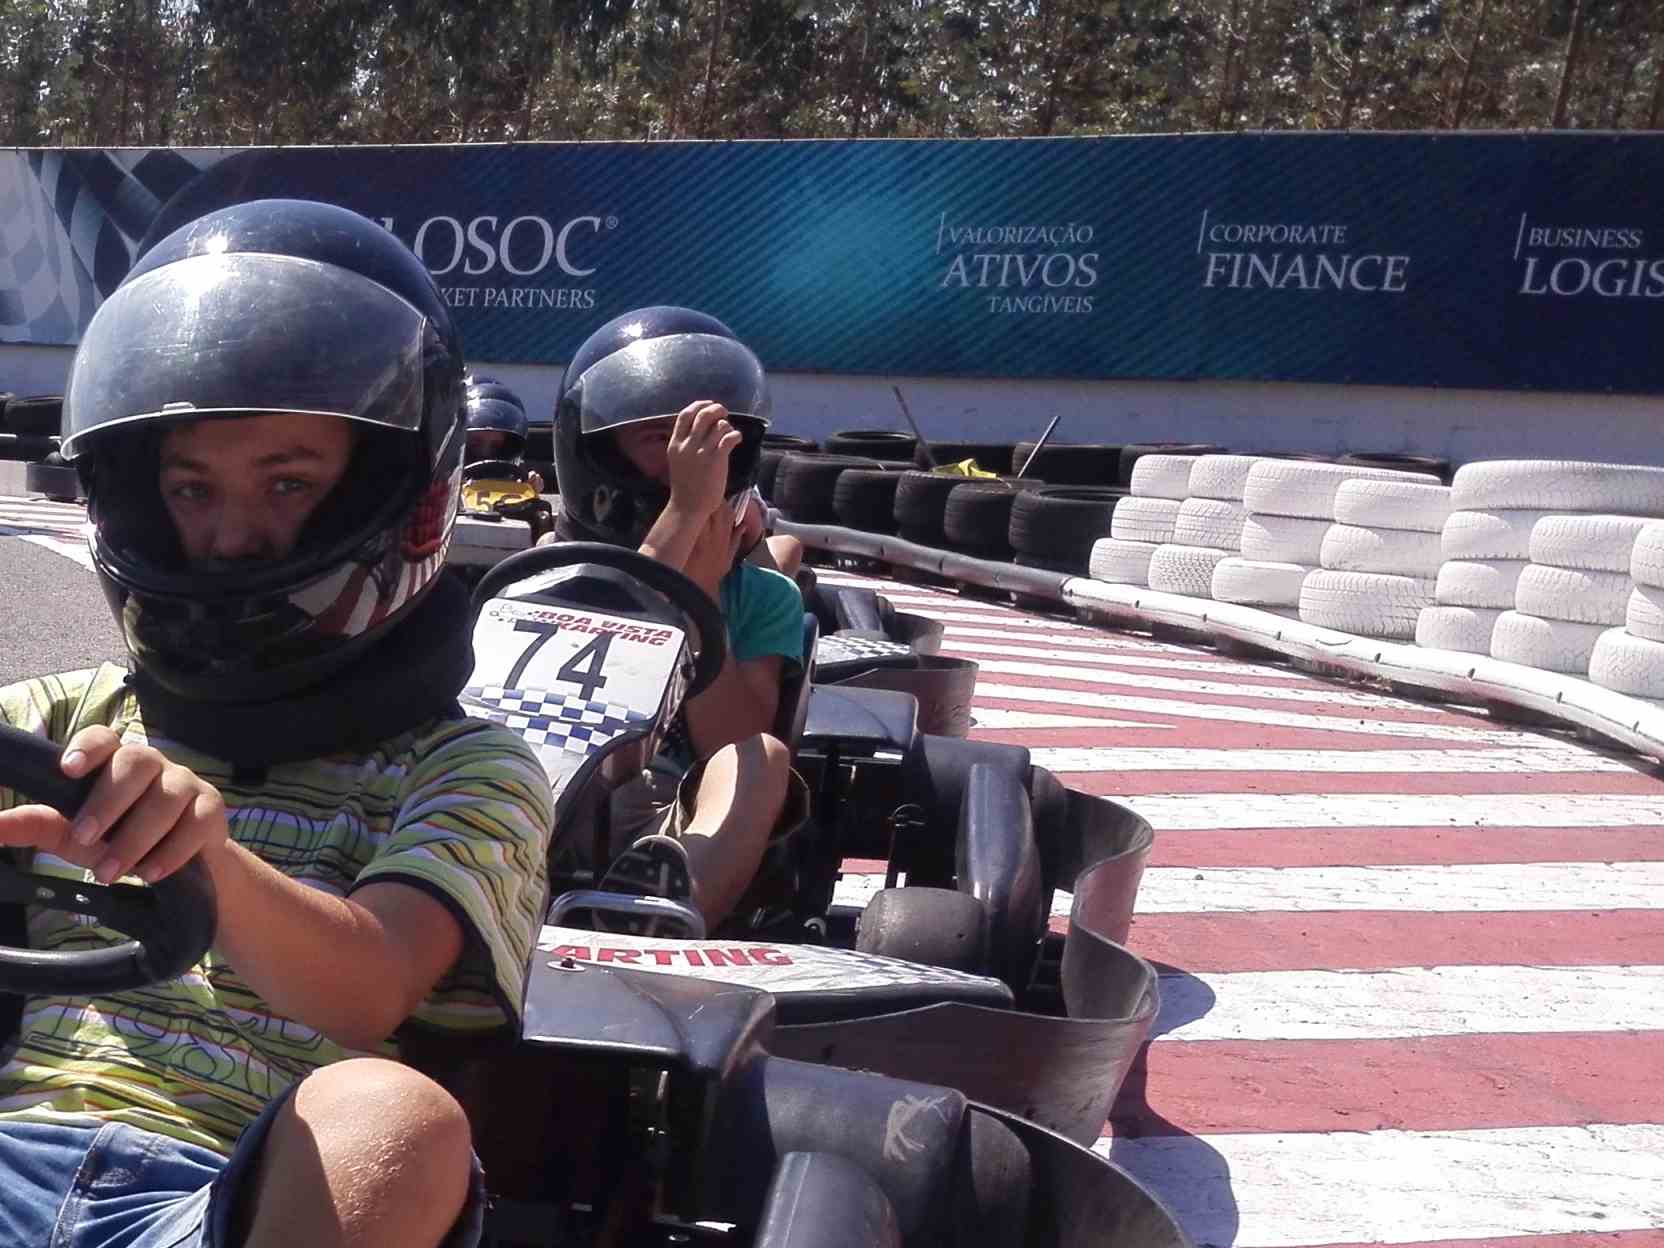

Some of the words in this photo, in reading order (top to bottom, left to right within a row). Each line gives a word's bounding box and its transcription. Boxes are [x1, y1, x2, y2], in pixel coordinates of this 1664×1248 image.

[949, 223, 1094, 247] VALORIZAÇÃO
[1209, 224, 1348, 245] CORPORATE
[1528, 226, 1644, 249] BUSINESS
[940, 253, 1099, 288] ATIVOS
[1202, 252, 1410, 293] FINANCE
[440, 288, 478, 307] KET
[485, 288, 595, 309] PARTNERS
[537, 611, 592, 625] BOA
[603, 620, 673, 639] VISTA
[503, 619, 616, 702] 74
[549, 944, 795, 967] ARTING
